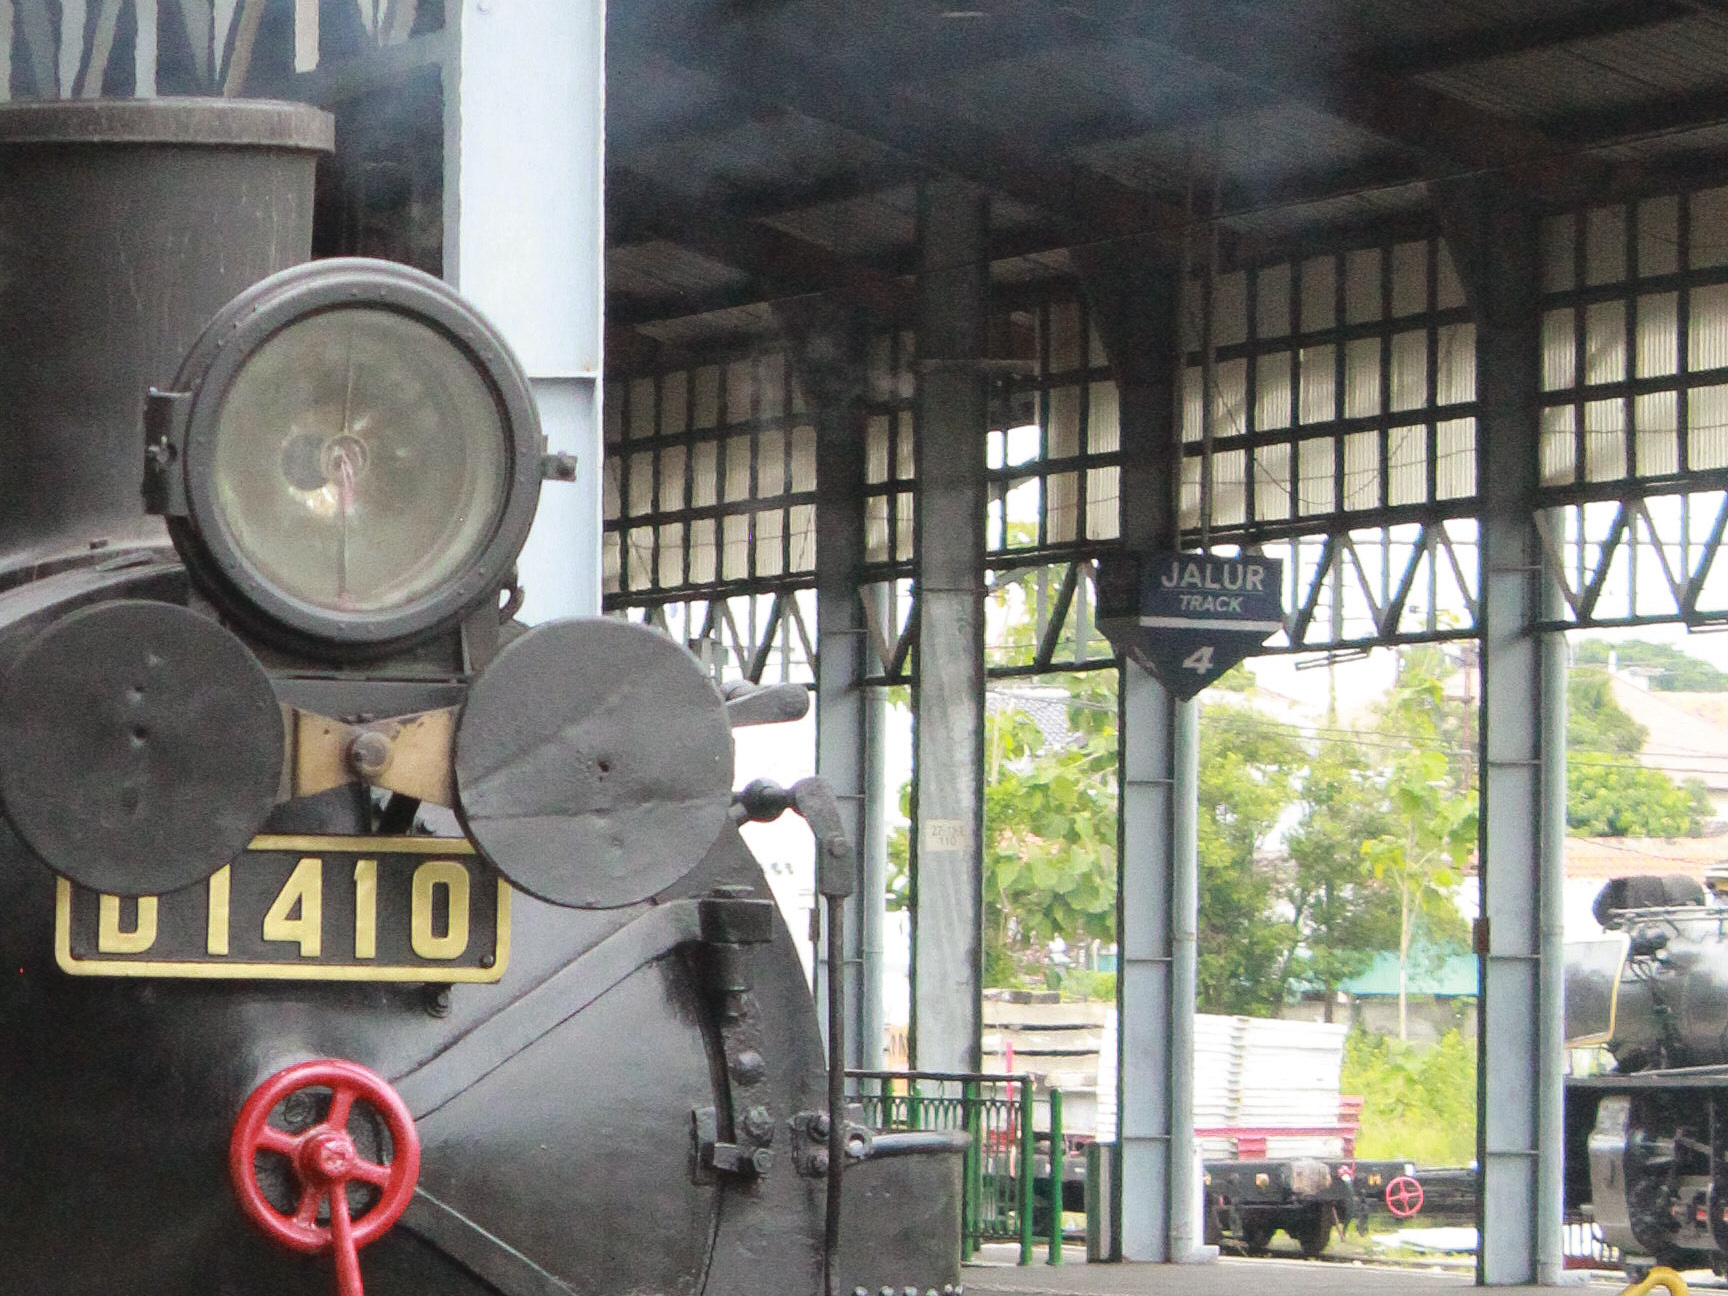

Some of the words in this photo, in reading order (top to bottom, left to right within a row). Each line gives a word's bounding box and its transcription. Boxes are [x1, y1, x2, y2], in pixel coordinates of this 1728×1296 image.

[1160, 561, 1263, 591] JALUR
[1178, 594, 1244, 613] TRACK
[1181, 646, 1215, 676] 4
